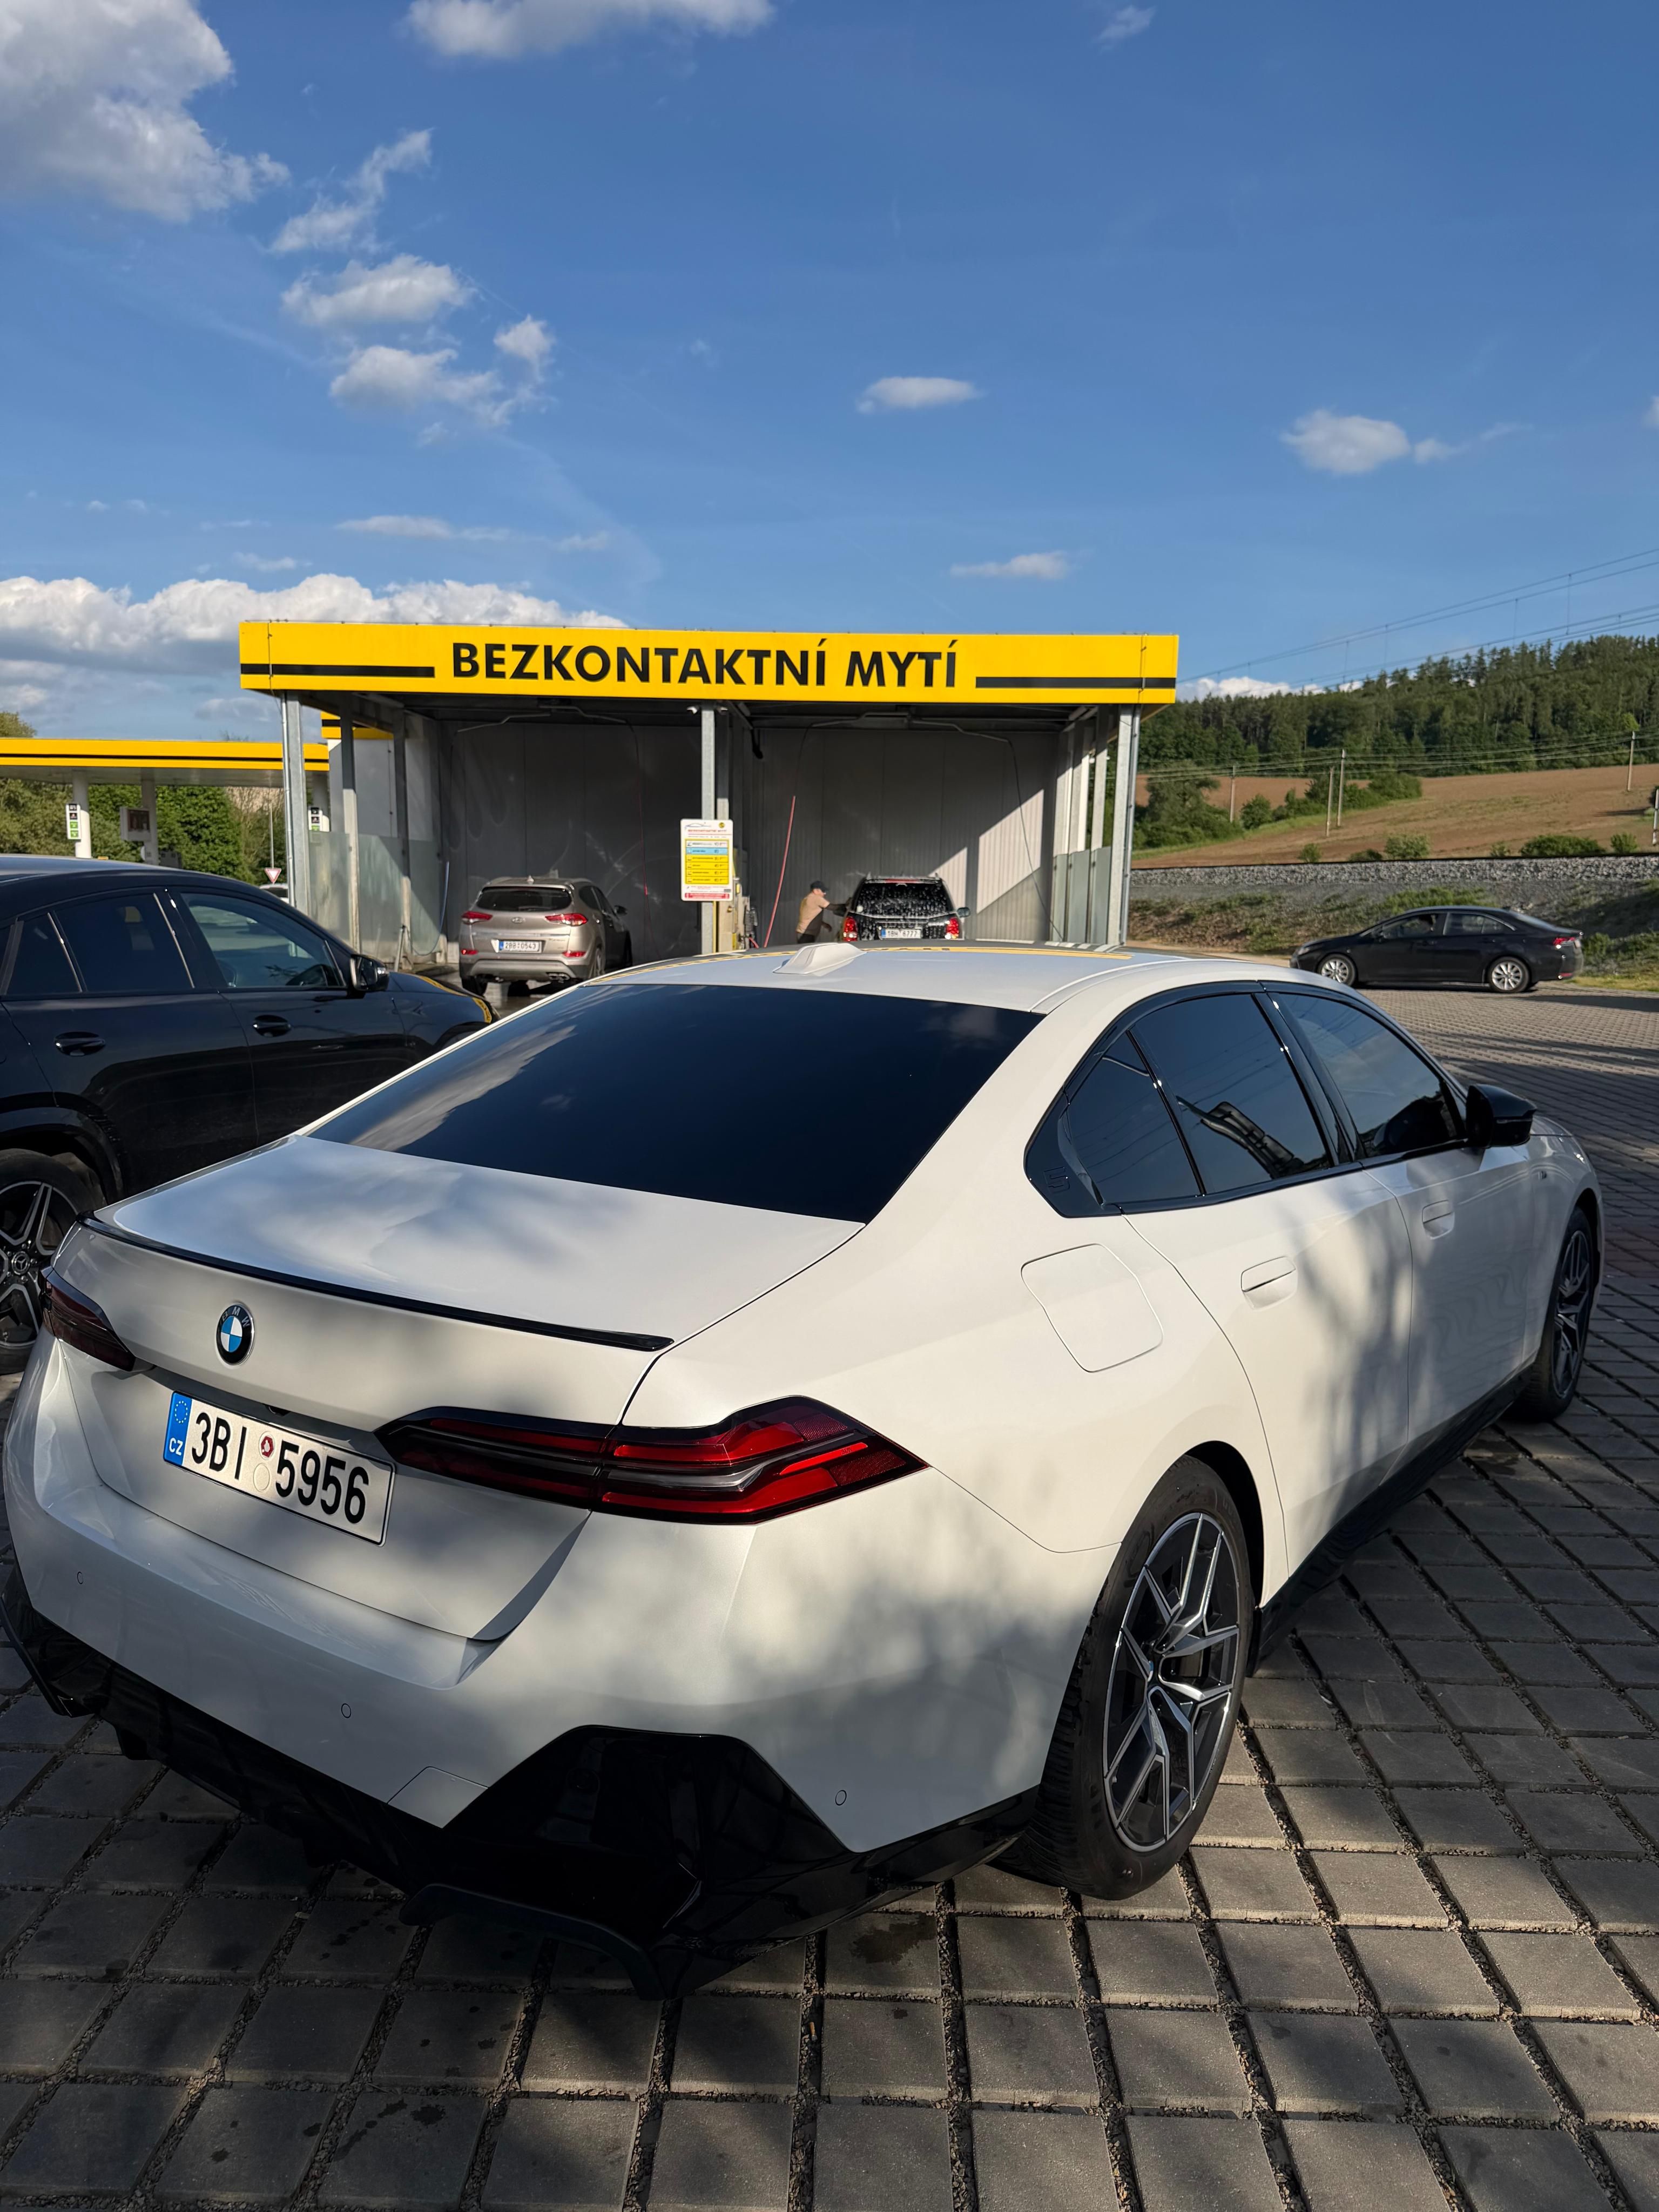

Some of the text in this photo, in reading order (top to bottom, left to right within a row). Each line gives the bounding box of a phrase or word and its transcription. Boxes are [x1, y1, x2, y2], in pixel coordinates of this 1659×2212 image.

[452, 638, 959, 687] BEZKONTAKTNÍ MYTÍ
[221, 1306, 251, 1328] BMW
[168, 1437, 183, 1456] CZ
[191, 1412, 369, 1524] 3BI 5956
